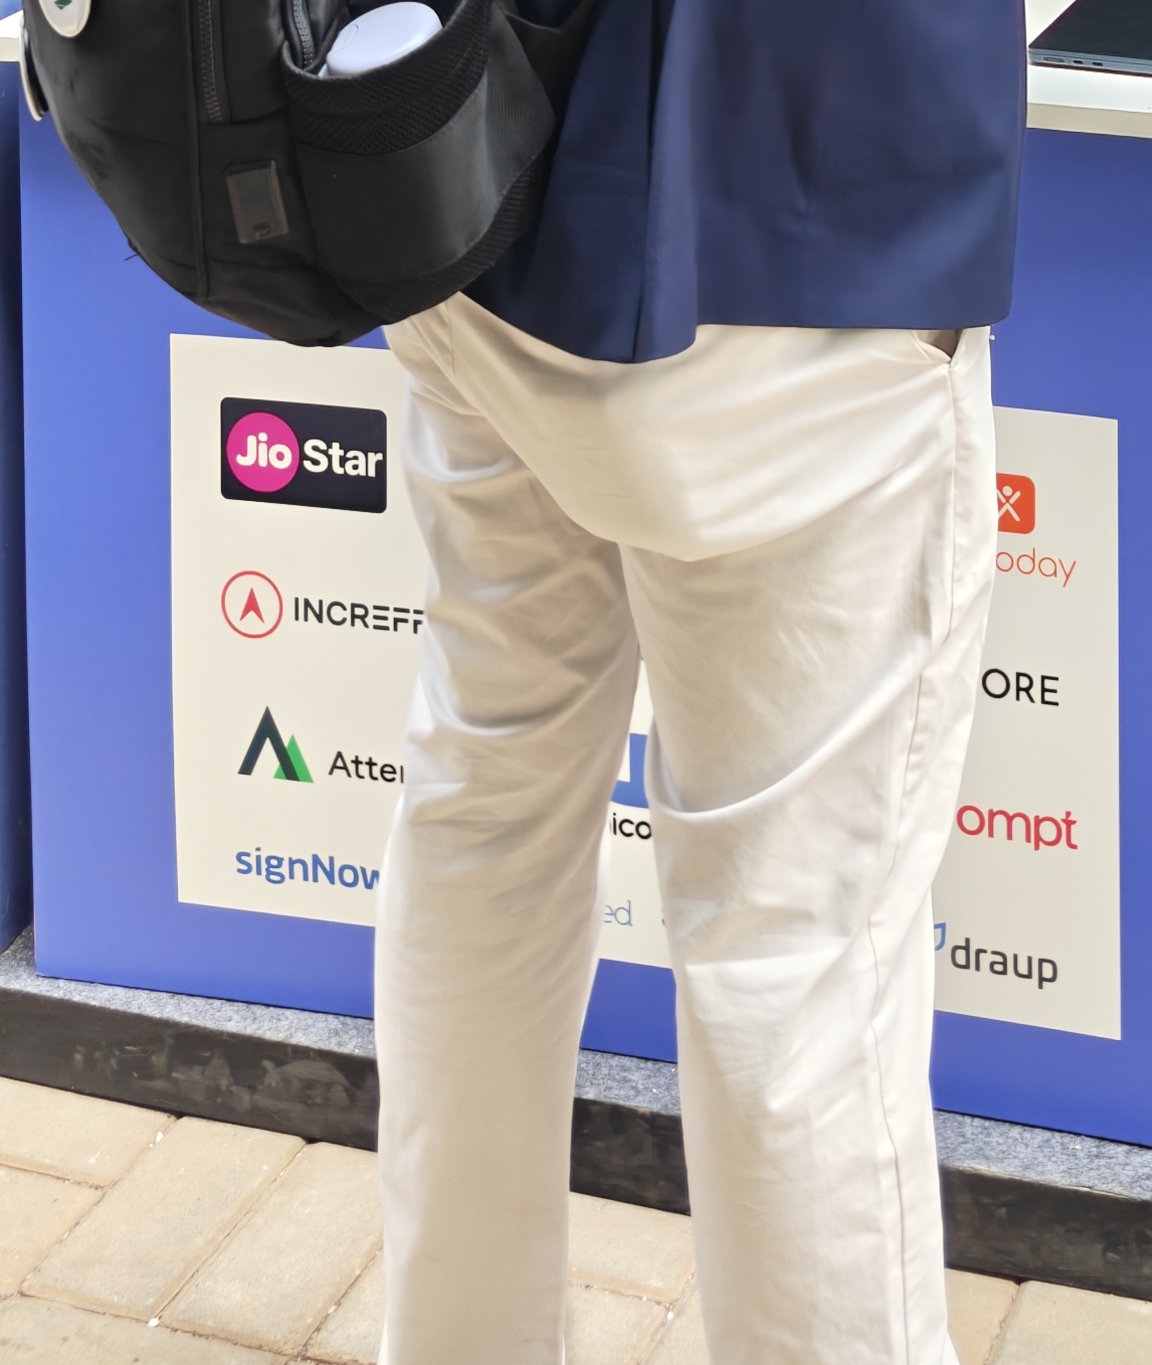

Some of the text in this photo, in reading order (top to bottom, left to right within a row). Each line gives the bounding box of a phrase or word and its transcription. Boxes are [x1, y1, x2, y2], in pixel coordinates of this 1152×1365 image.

[235, 432, 384, 479] Jio Star
[294, 596, 425, 635] INCREFF
[328, 750, 404, 784] Atte
[609, 812, 653, 840] ico
[950, 936, 1058, 990] draup
